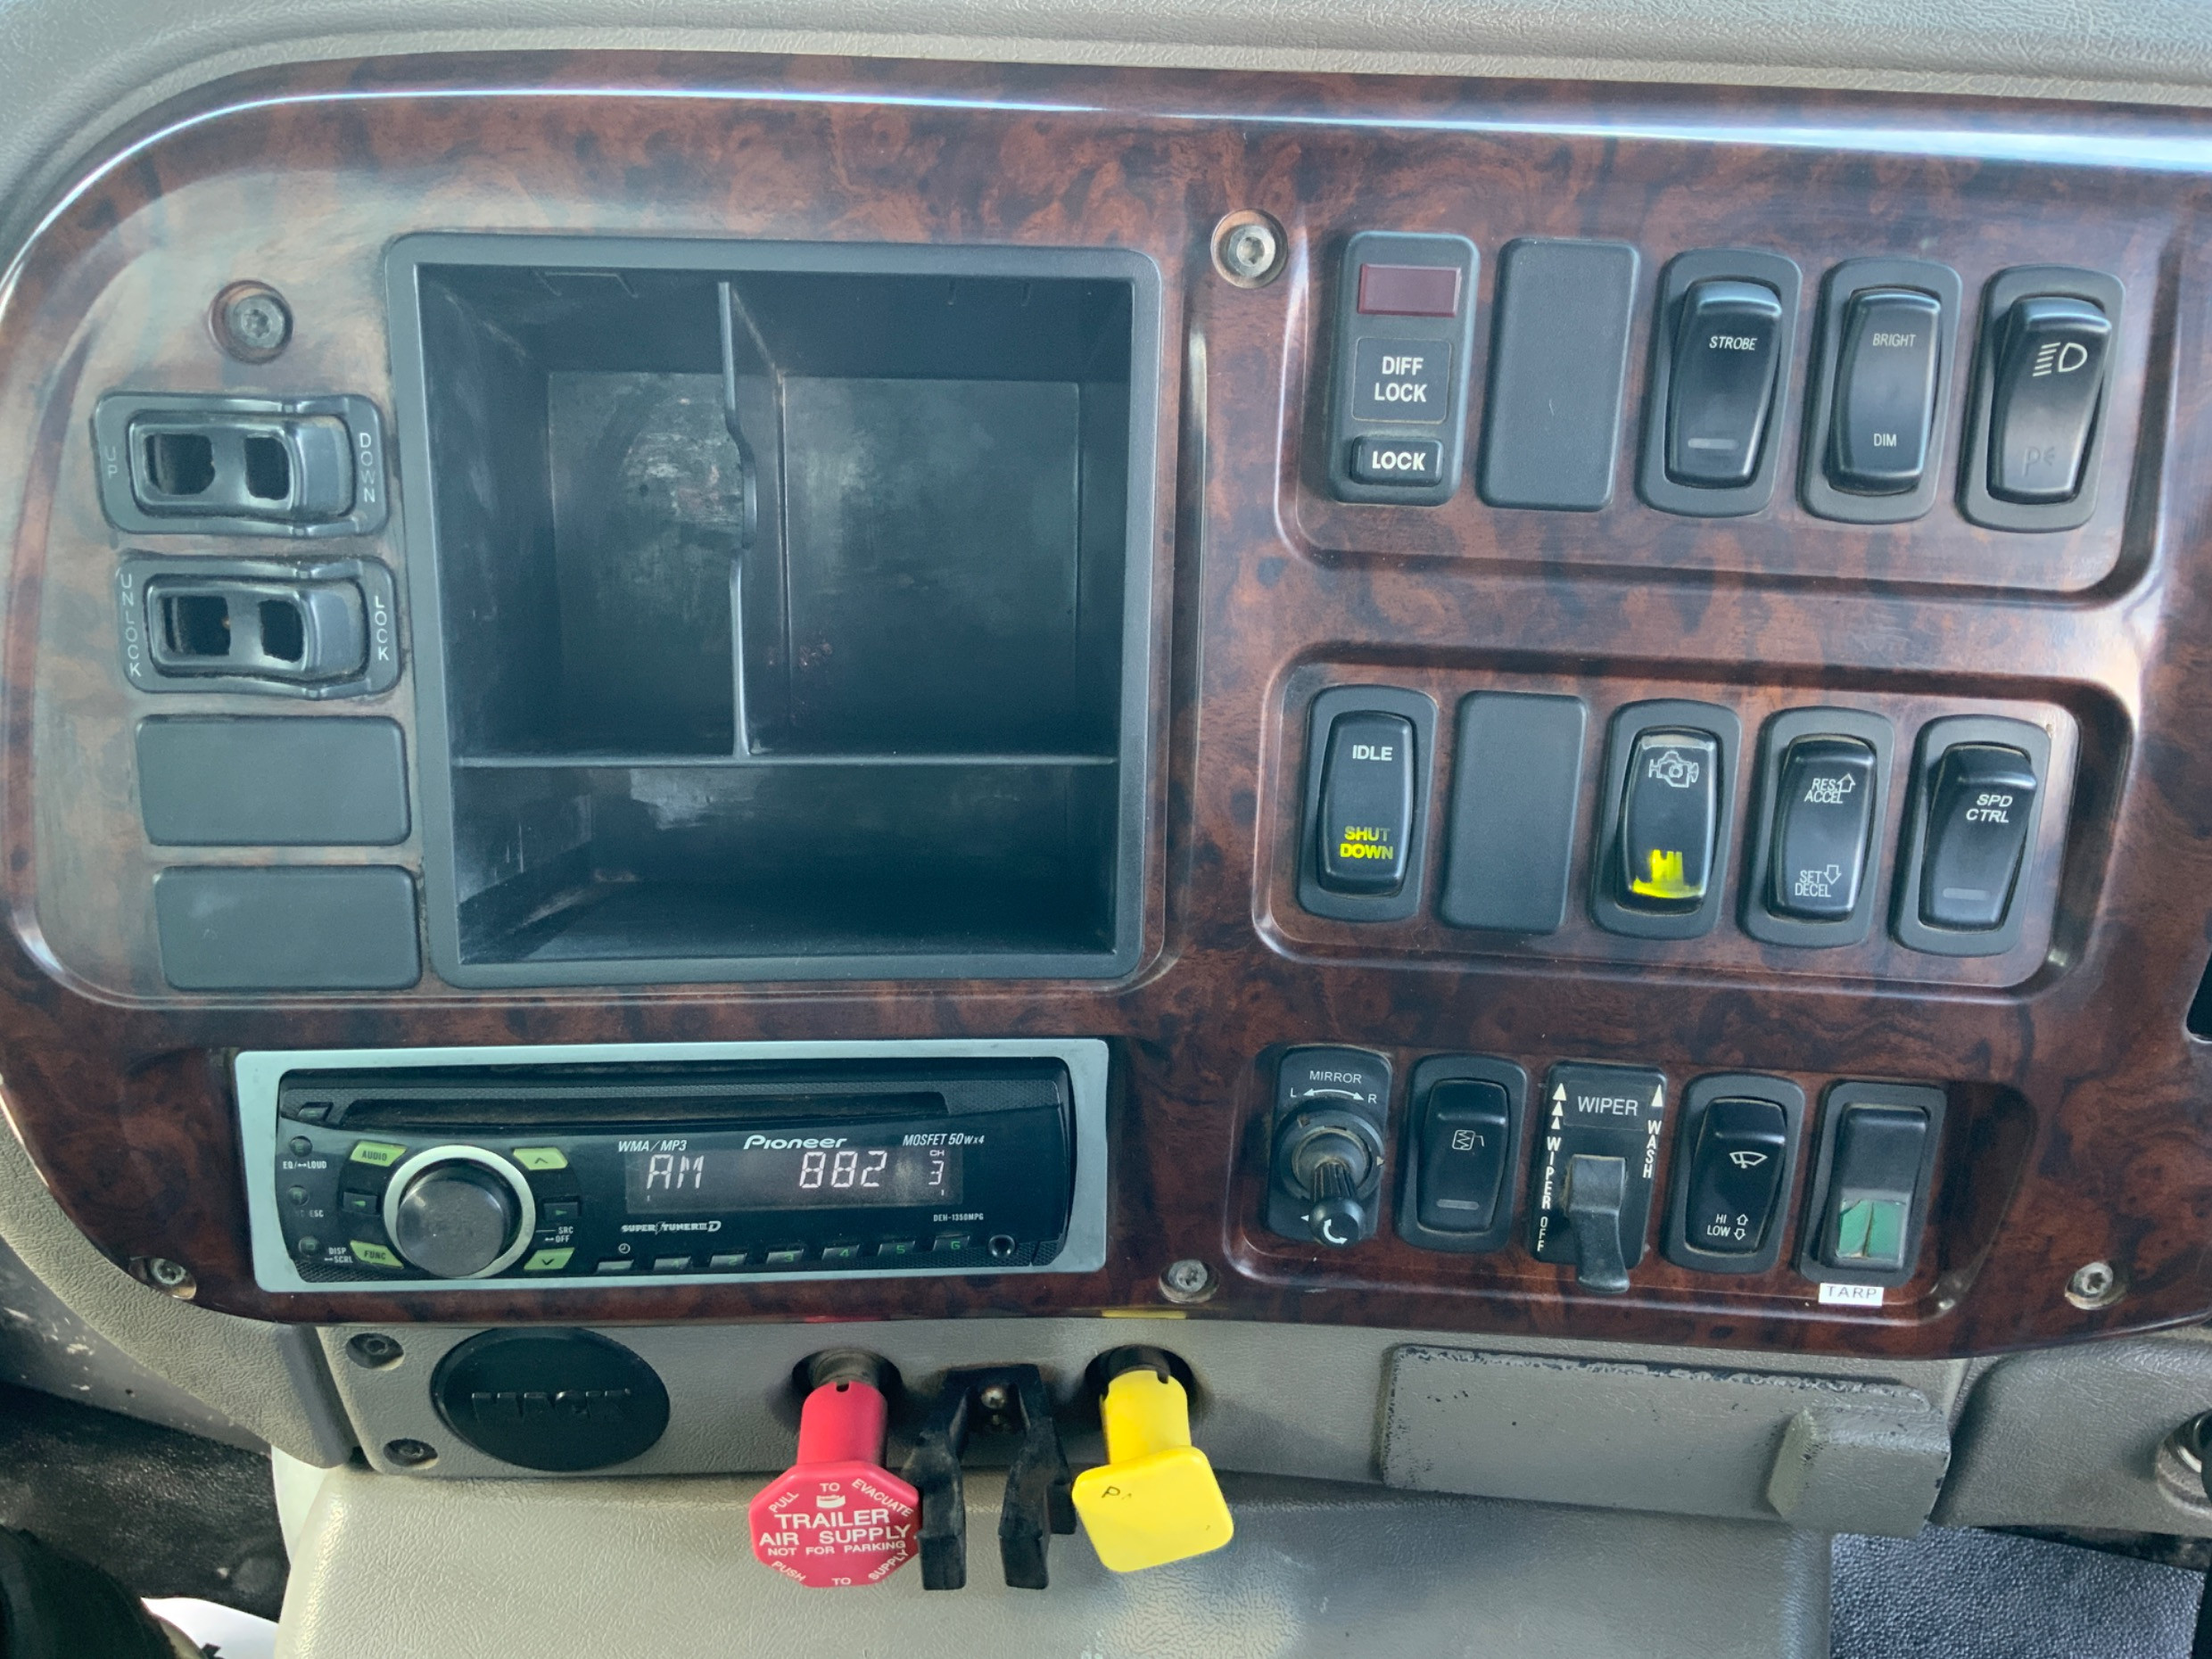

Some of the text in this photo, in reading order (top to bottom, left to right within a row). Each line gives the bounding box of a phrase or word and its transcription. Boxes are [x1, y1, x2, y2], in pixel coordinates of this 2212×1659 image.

[1708, 334, 1758, 351] STROBE
[1872, 333, 1918, 348] BRIGHT
[1382, 356, 1424, 376] DIFF
[1374, 383, 1427, 403] LOCK
[1873, 433, 1897, 447] DIM
[107, 447, 118, 478] UP
[359, 433, 376, 503] DOWN
[1372, 450, 1426, 472] LOCK
[120, 574, 142, 677] UNLOCK
[374, 595, 390, 661] LOCK
[1351, 744, 1393, 762] IDLE
[1803, 791, 1844, 805] ACCEL
[1976, 794, 2013, 808] SPD
[1966, 808, 2010, 823] CTRL
[1344, 826, 1391, 842] SHUT
[1340, 843, 1394, 860] DOWN
[1799, 870, 1822, 884] SET
[1795, 883, 1831, 897] DECEL
[1309, 1069, 1363, 1085] MIRROR
[1290, 1086, 1297, 1098] L
[1367, 1094, 1378, 1104] R
[1577, 1095, 1638, 1117] WIPER
[743, 1135, 847, 1150] Pioneer
[902, 1134, 947, 1147] MOSFET
[361, 1150, 387, 1161] AUDIO
[929, 1149, 945, 1158] CH
[1642, 1120, 1662, 1179] WASH
[646, 1153, 705, 1190] AM
[799, 1150, 887, 1189] 882
[929, 1160, 945, 1185] 3
[1537, 1136, 1562, 1252] WIPER OFF
[309, 1209, 324, 1217] ESC
[1715, 1213, 1727, 1225] HI
[557, 1226, 574, 1234] SRC
[1706, 1225, 1731, 1237] LOW
[555, 1234, 570, 1242] OFF
[328, 1247, 346, 1255] DISP
[364, 1250, 386, 1260] FUNC
[896, 1244, 905, 1255] 5
[334, 1256, 353, 1264] SCRL
[784, 1252, 795, 1263] 3
[1826, 1285, 1878, 1300] TARP
[768, 1477, 914, 1518] PULL TO EVACUATE
[773, 1508, 890, 1531] TRAILER
[759, 1523, 912, 1547] AIR SUPPLY
[767, 1539, 907, 1556] NOT FOR PARKING
[771, 1548, 910, 1587] PUSH TO SUPPLY
